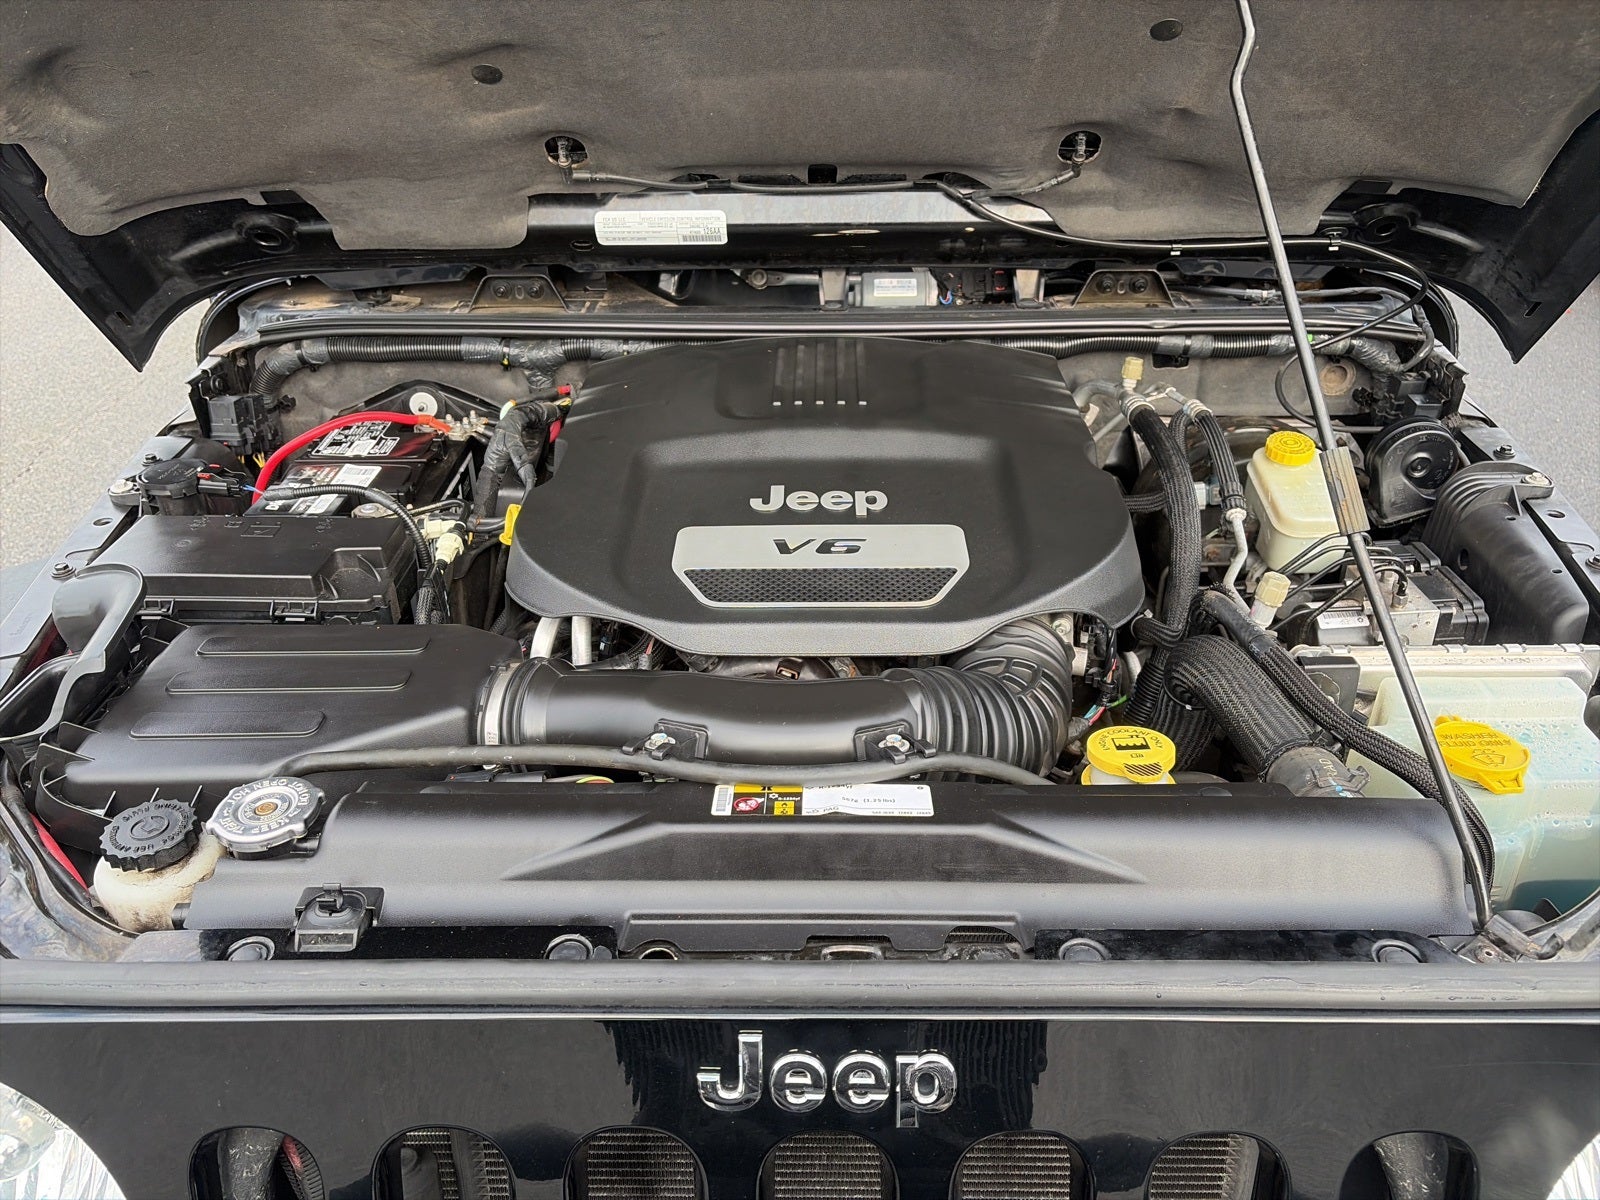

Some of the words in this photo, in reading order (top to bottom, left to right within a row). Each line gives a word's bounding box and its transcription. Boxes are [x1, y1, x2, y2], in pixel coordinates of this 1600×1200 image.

[750, 485, 888, 517] Jeep
[773, 538, 867, 555] V6
[1439, 740, 1476, 748] FLUID
[253, 779, 288, 791] OPEN
[227, 789, 251, 805] HOT
[219, 818, 245, 834] TIGHT
[251, 817, 290, 834] KEEP
[696, 1029, 958, 1128] Jeep
